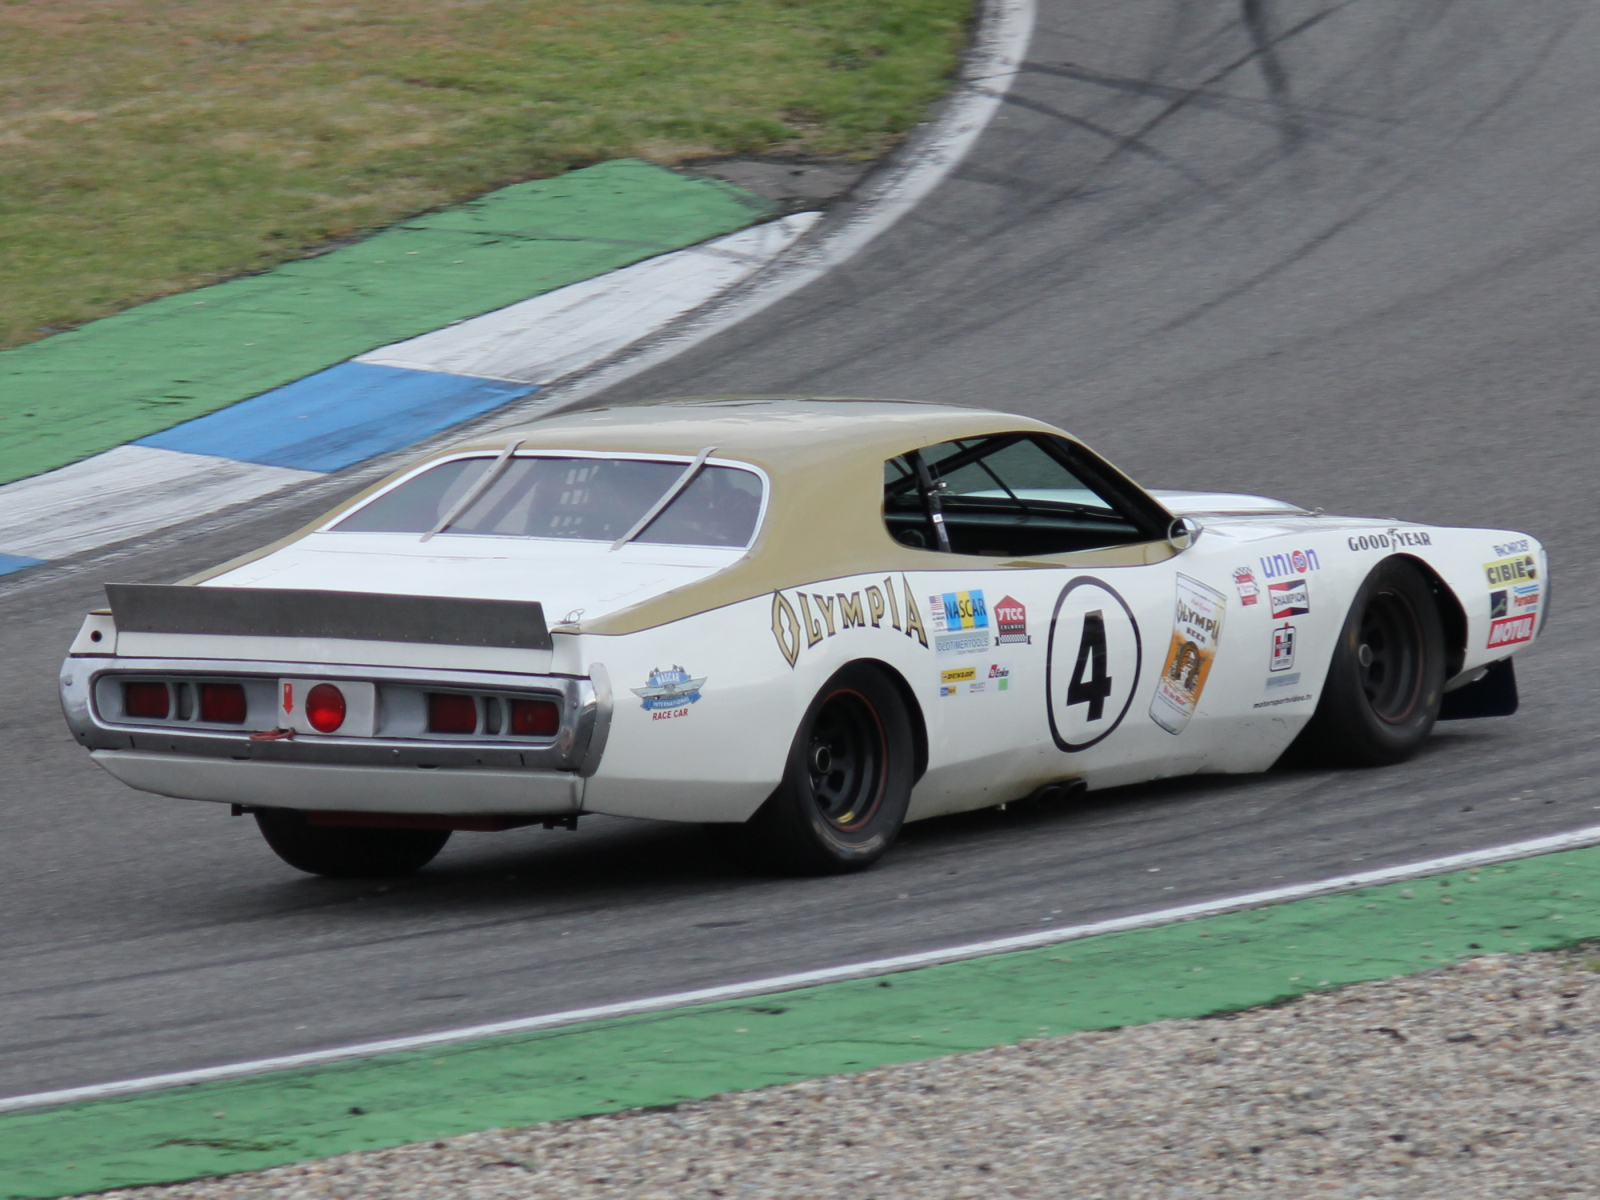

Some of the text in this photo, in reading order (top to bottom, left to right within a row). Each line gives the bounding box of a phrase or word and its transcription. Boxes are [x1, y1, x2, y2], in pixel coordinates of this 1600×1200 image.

[1273, 592, 1308, 607] CHAMPION
[943, 598, 987, 620] NASCAR
[997, 607, 1025, 621] YTCC
[771, 571, 929, 670] OLYMPIA
[1186, 626, 1206, 645] BEER
[1488, 617, 1533, 645] MOTUL
[937, 637, 989, 652] OLDTIMERTOOLS
[1066, 609, 1112, 722] 4
[655, 672, 681, 686] NASCAR
[946, 670, 975, 681] DUNLOP
[652, 696, 690, 708] INTERNATIONAL
[652, 708, 689, 721] RACE CAR
